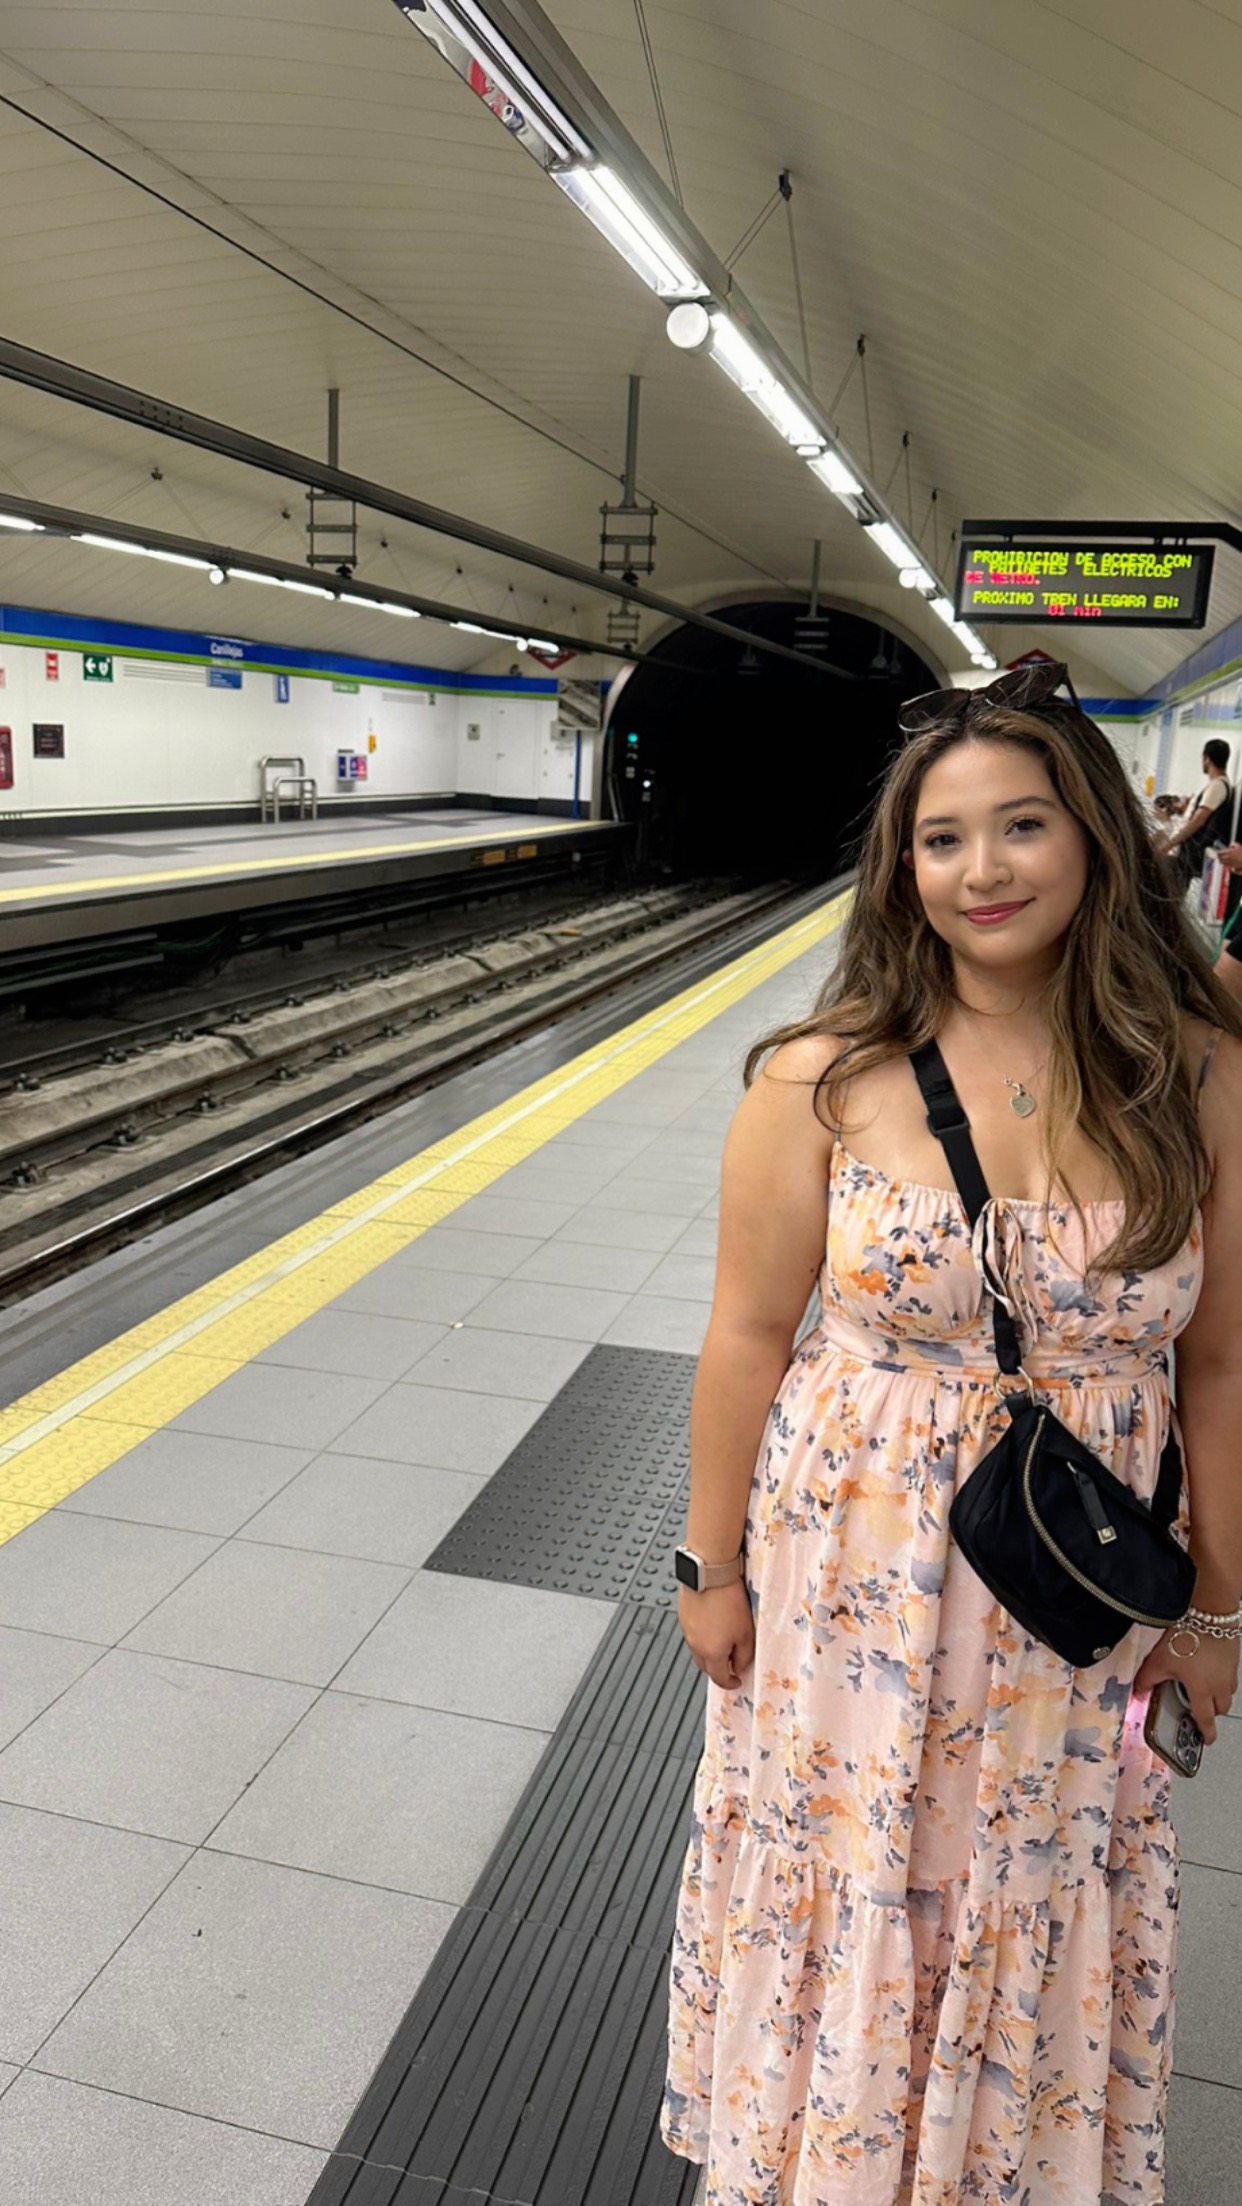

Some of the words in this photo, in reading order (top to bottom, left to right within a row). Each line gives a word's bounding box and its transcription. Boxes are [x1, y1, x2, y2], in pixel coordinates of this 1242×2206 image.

[973, 550, 1069, 566] PROHIBICION
[1075, 552, 1095, 566] DE
[1101, 553, 1156, 567] ACCESO
[1163, 554, 1192, 568] CON
[1083, 562, 1172, 577] ELECTRICOS
[973, 591, 1034, 605] PROXIMO
[1041, 593, 1077, 606] TREN
[1084, 594, 1147, 608] LLEGARA
[1153, 595, 1179, 609] EN:
